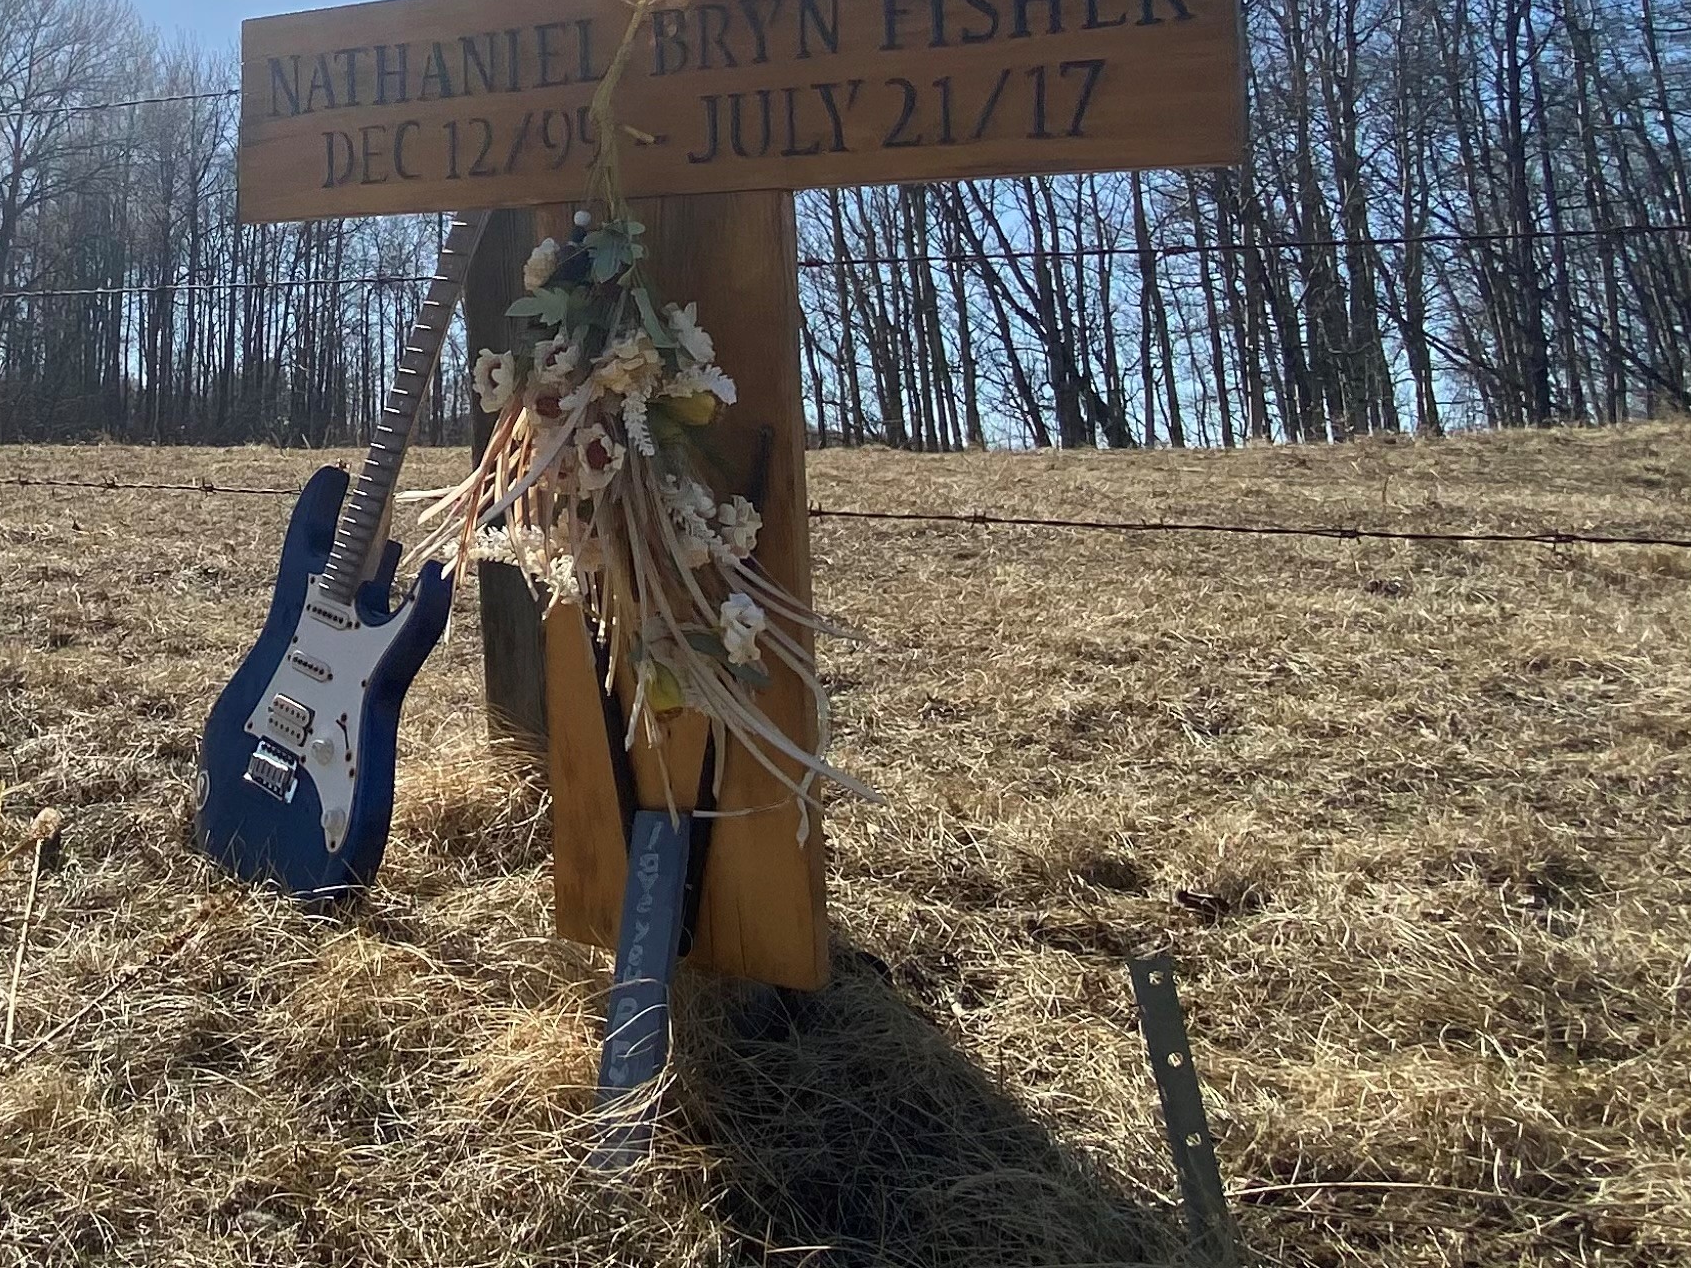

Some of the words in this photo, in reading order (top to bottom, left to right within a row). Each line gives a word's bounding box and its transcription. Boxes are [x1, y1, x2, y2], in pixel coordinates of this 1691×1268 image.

[266, 18, 608, 117] NATHANIEL
[320, 119, 421, 189] DEC
[686, 79, 864, 165] JULY
[879, 59, 1106, 149] 21/17
